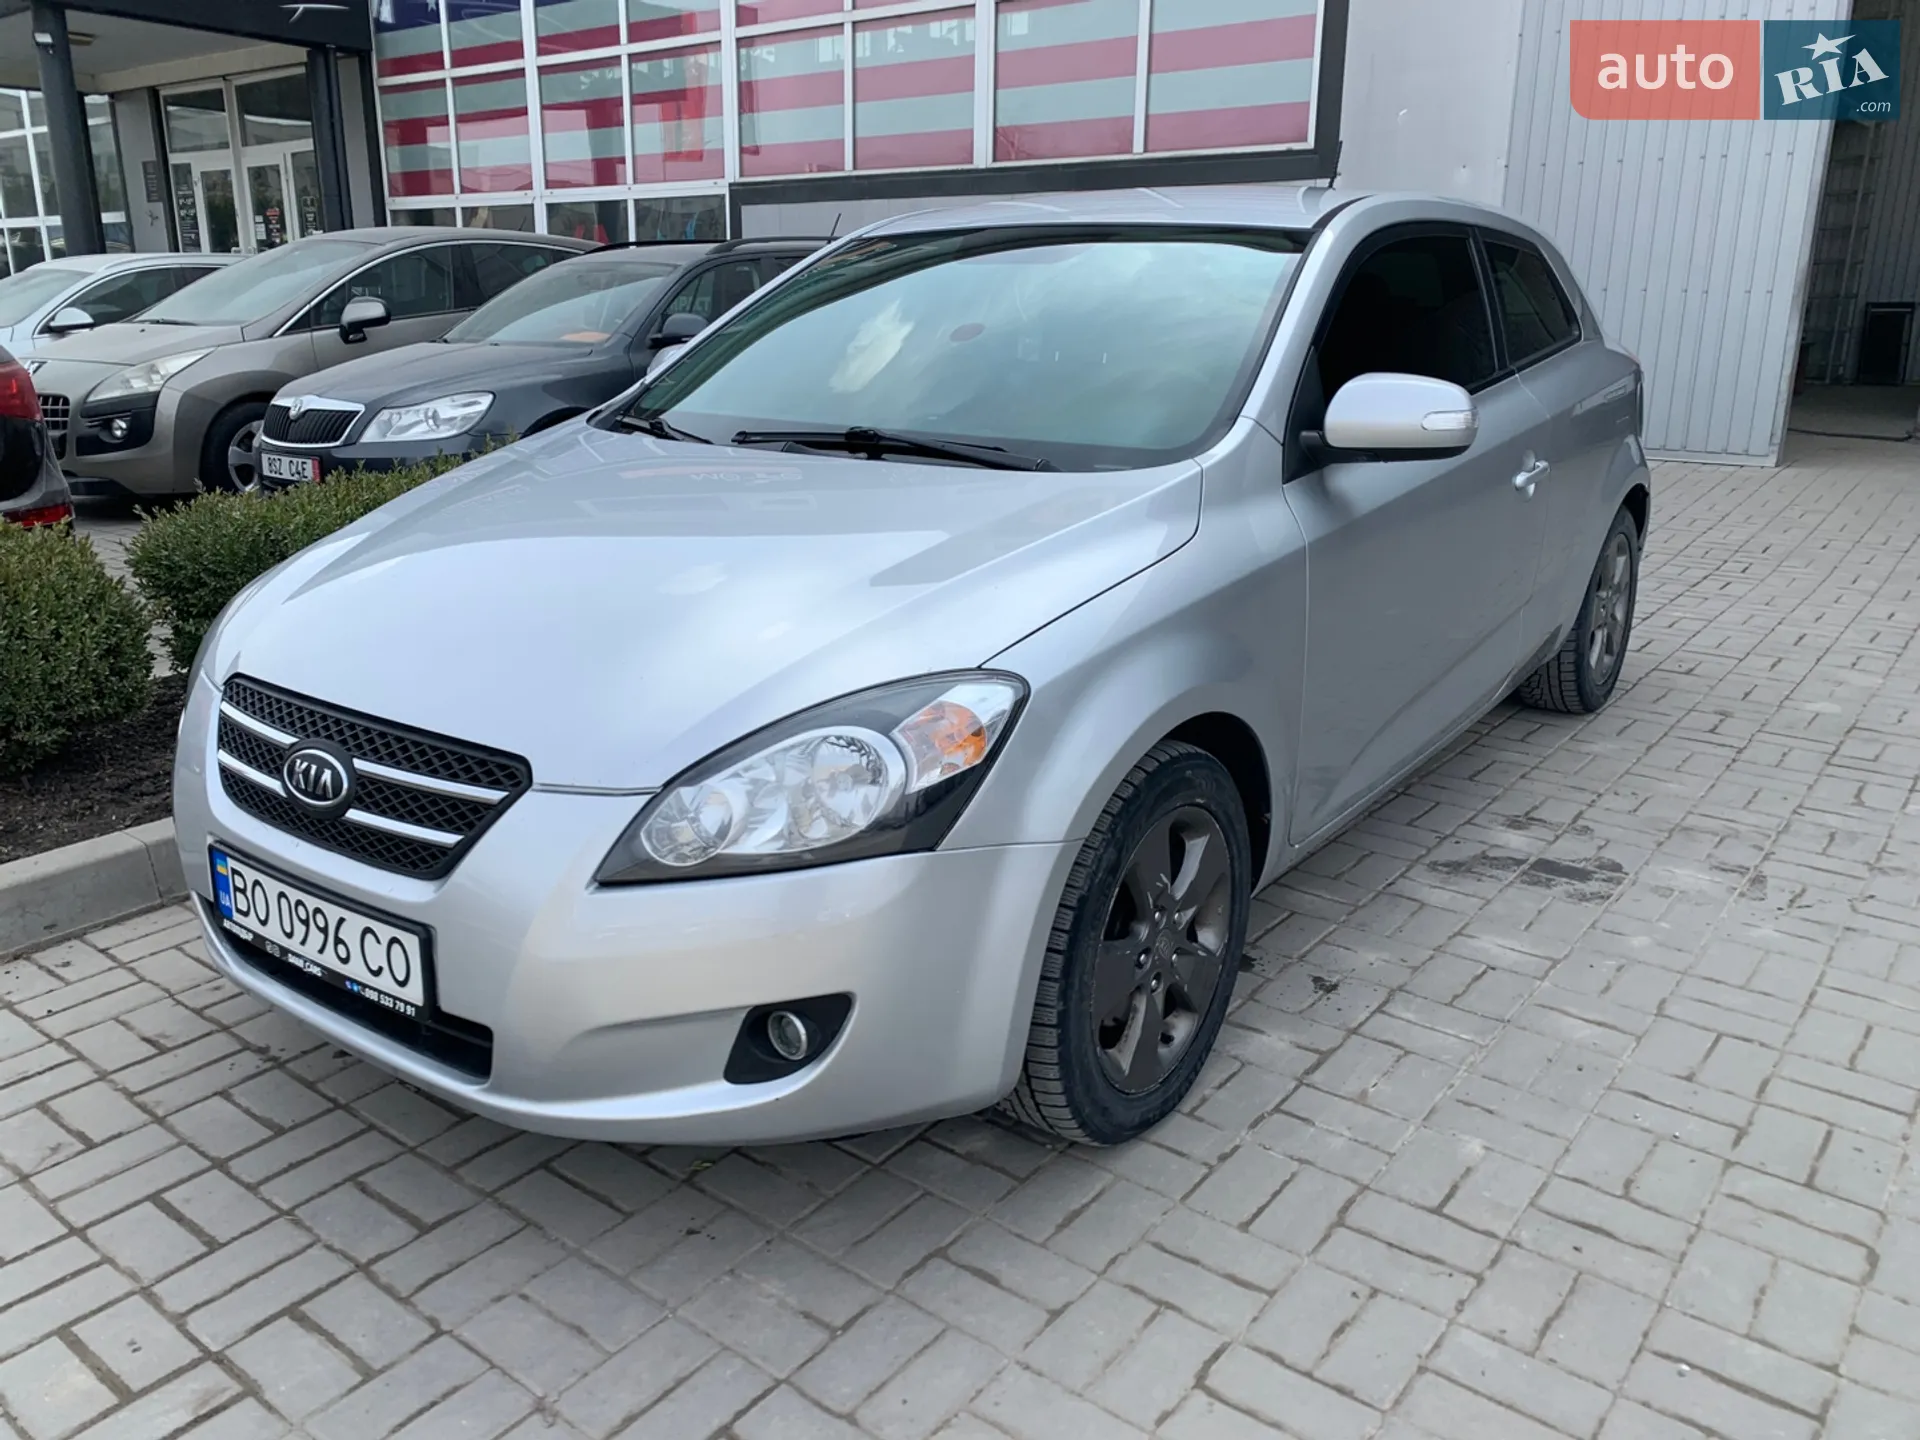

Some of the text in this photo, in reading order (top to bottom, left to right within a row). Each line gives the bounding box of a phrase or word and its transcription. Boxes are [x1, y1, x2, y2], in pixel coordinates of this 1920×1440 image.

[292, 758, 333, 799] KIA
[220, 890, 231, 908] UA
[230, 866, 411, 988] BO 0996 CO
[380, 994, 393, 1008] 533
